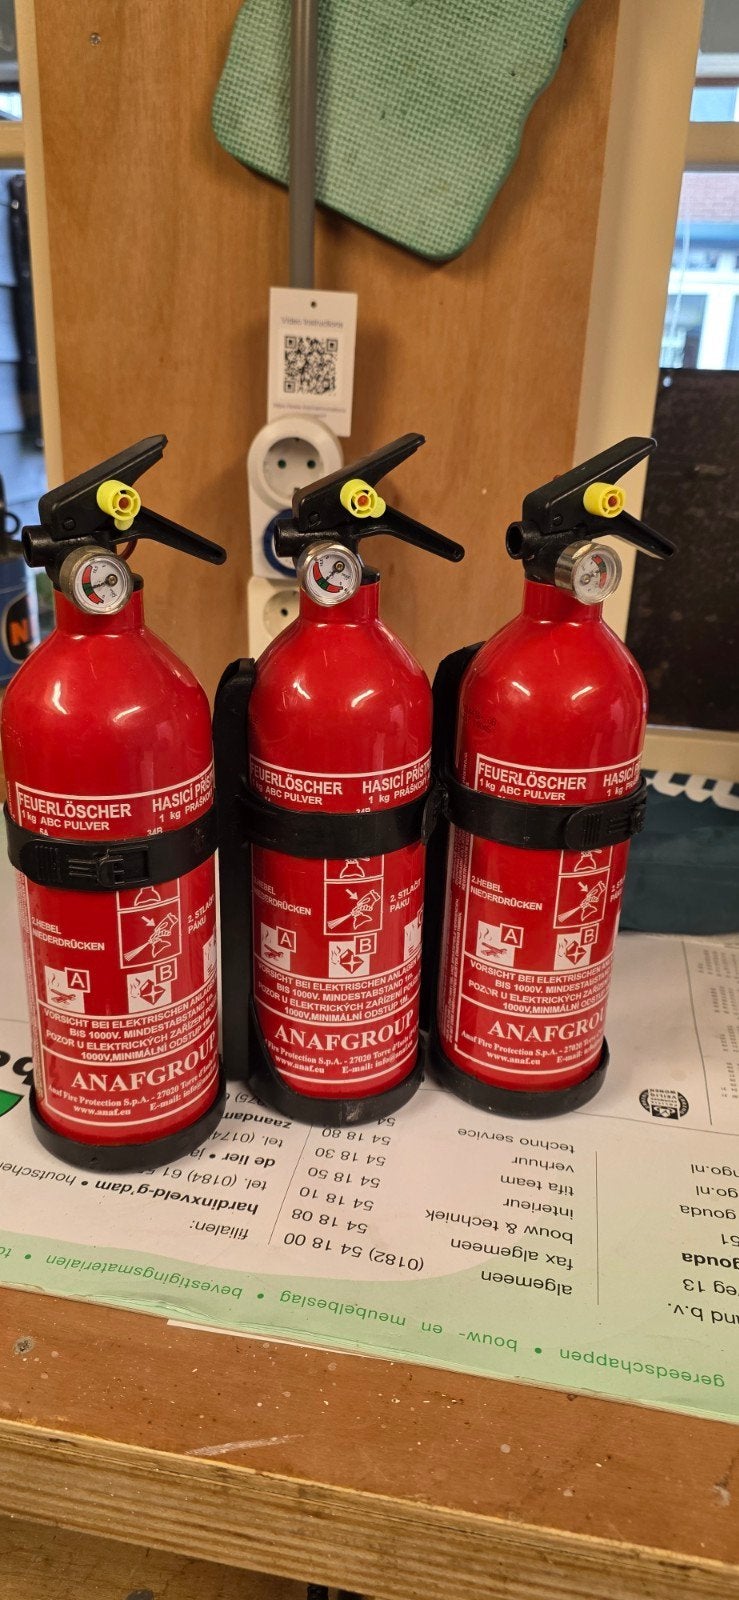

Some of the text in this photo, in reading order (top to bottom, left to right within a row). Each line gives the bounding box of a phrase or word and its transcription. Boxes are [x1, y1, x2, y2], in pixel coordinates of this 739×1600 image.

[250, 764, 343, 795] FEUERLÖSCHER
[362, 774, 404, 794] HASICÍ
[478, 762, 586, 790] FEUERLÖSCHER
[152, 783, 193, 812] HASICÍ
[265, 786, 322, 805] ABC PULVER
[368, 794, 389, 804] 1 kg
[479, 778, 566, 801] 1 kg ABC PULVER
[18, 792, 131, 818] FEUERLÖSCHER
[21, 810, 110, 831] 1 kg ABC PULVER
[159, 810, 181, 822] 1 kg
[471, 875, 503, 893] 2.HEBEL
[389, 897, 410, 913] PÁKU
[390, 894, 396, 902] 2.
[470, 885, 543, 911] NIEDERDRÜCKEN
[32, 917, 61, 934] 2.HEBEL
[32, 927, 105, 951] NIEDERDRÜCKEN
[280, 932, 292, 948] A
[360, 938, 371, 952] B
[504, 929, 518, 944] A
[584, 929, 594, 944] B
[70, 972, 85, 988] A
[160, 965, 172, 981] B
[470, 959, 516, 980] VORSICHT
[518, 974, 534, 983] BEI
[276, 983, 290, 994] BIS
[292, 988, 320, 1001] 1000V.
[322, 980, 404, 1001] MINDESTABSTAND
[295, 980, 311, 990] BEI
[313, 976, 387, 991] ELEKTRISCHEN
[469, 979, 498, 998] POZOR
[510, 991, 581, 1004] ELEKTRICKÝCH
[495, 980, 543, 994] BIS 1000V.
[259, 981, 281, 1000] POZOR
[290, 999, 363, 1012] ELEKTRICKÝCH
[366, 987, 403, 1009] ZAŘÍZENÍ
[44, 1009, 89, 1028] VORSICHT
[91, 1020, 109, 1029] BEI
[112, 1003, 189, 1029] ELEKTRISCHEN
[70, 1028, 86, 1037] BIS
[89, 1030, 121, 1039] 1000V.
[123, 1001, 205, 1039] MINDESTABSTAND
[364, 1001, 399, 1019] ODSTUP
[46, 1029, 75, 1047] POZOR
[77, 1041, 84, 1049] U
[86, 1031, 168, 1050] ELEKTRICKÝCH
[169, 1024, 201, 1049] ODSTUP
[274, 1009, 414, 1051] ANAFGROUP
[461, 1030, 558, 1058] Anaf Fire Protection S.p.A.
[71, 1031, 217, 1091] ANAFGROUP
[275, 1055, 373, 1074] www.anaf.eu E-mail:
[280, 1046, 317, 1064] Protection
[318, 1057, 343, 1067] S.p.A.
[349, 1054, 372, 1064] 27020
[487, 1051, 541, 1065] www.anaf.eu
[64, 1089, 78, 1102] Fire
[80, 1096, 121, 1107] Protection
[123, 1096, 150, 1108] S.p.A.
[156, 1085, 179, 1099] 27020
[74, 1094, 181, 1116] www.anaf.eu E-mail:
[262, 1135, 283, 1148] tel.
[321, 1127, 391, 1146] 54 18 80
[457, 1128, 575, 1154] techno service
[222, 1152, 276, 1169] de lier
[315, 1147, 386, 1167] 54 18 30
[511, 1156, 575, 1173] verhuur
[162, 1167, 182, 1179] 61
[187, 1169, 237, 1188] (0184)
[307, 1167, 381, 1189] 54 18 50
[245, 1178, 267, 1191] tel.
[500, 1175, 574, 1197] tifa team
[696, 1185, 738, 1199] go.nl
[299, 1186, 374, 1212] 54 18 10
[502, 1198, 574, 1220] interieur
[291, 1208, 368, 1234] 54 18 08
[679, 1204, 736, 1220] gouda
[190, 1220, 249, 1240] filialen:
[425, 1209, 573, 1245] bouw & techniek
[283, 1233, 424, 1272] (0182) 54 18 00
[450, 1238, 574, 1271] fax algemeen
[481, 1270, 573, 1296] algemeen
[682, 1278, 706, 1293] 13
[46, 1254, 725, 1388] gereedschappen bouw- en meubelbeslag bevestigingsmaterialen
[667, 1303, 704, 1322] b.v.
